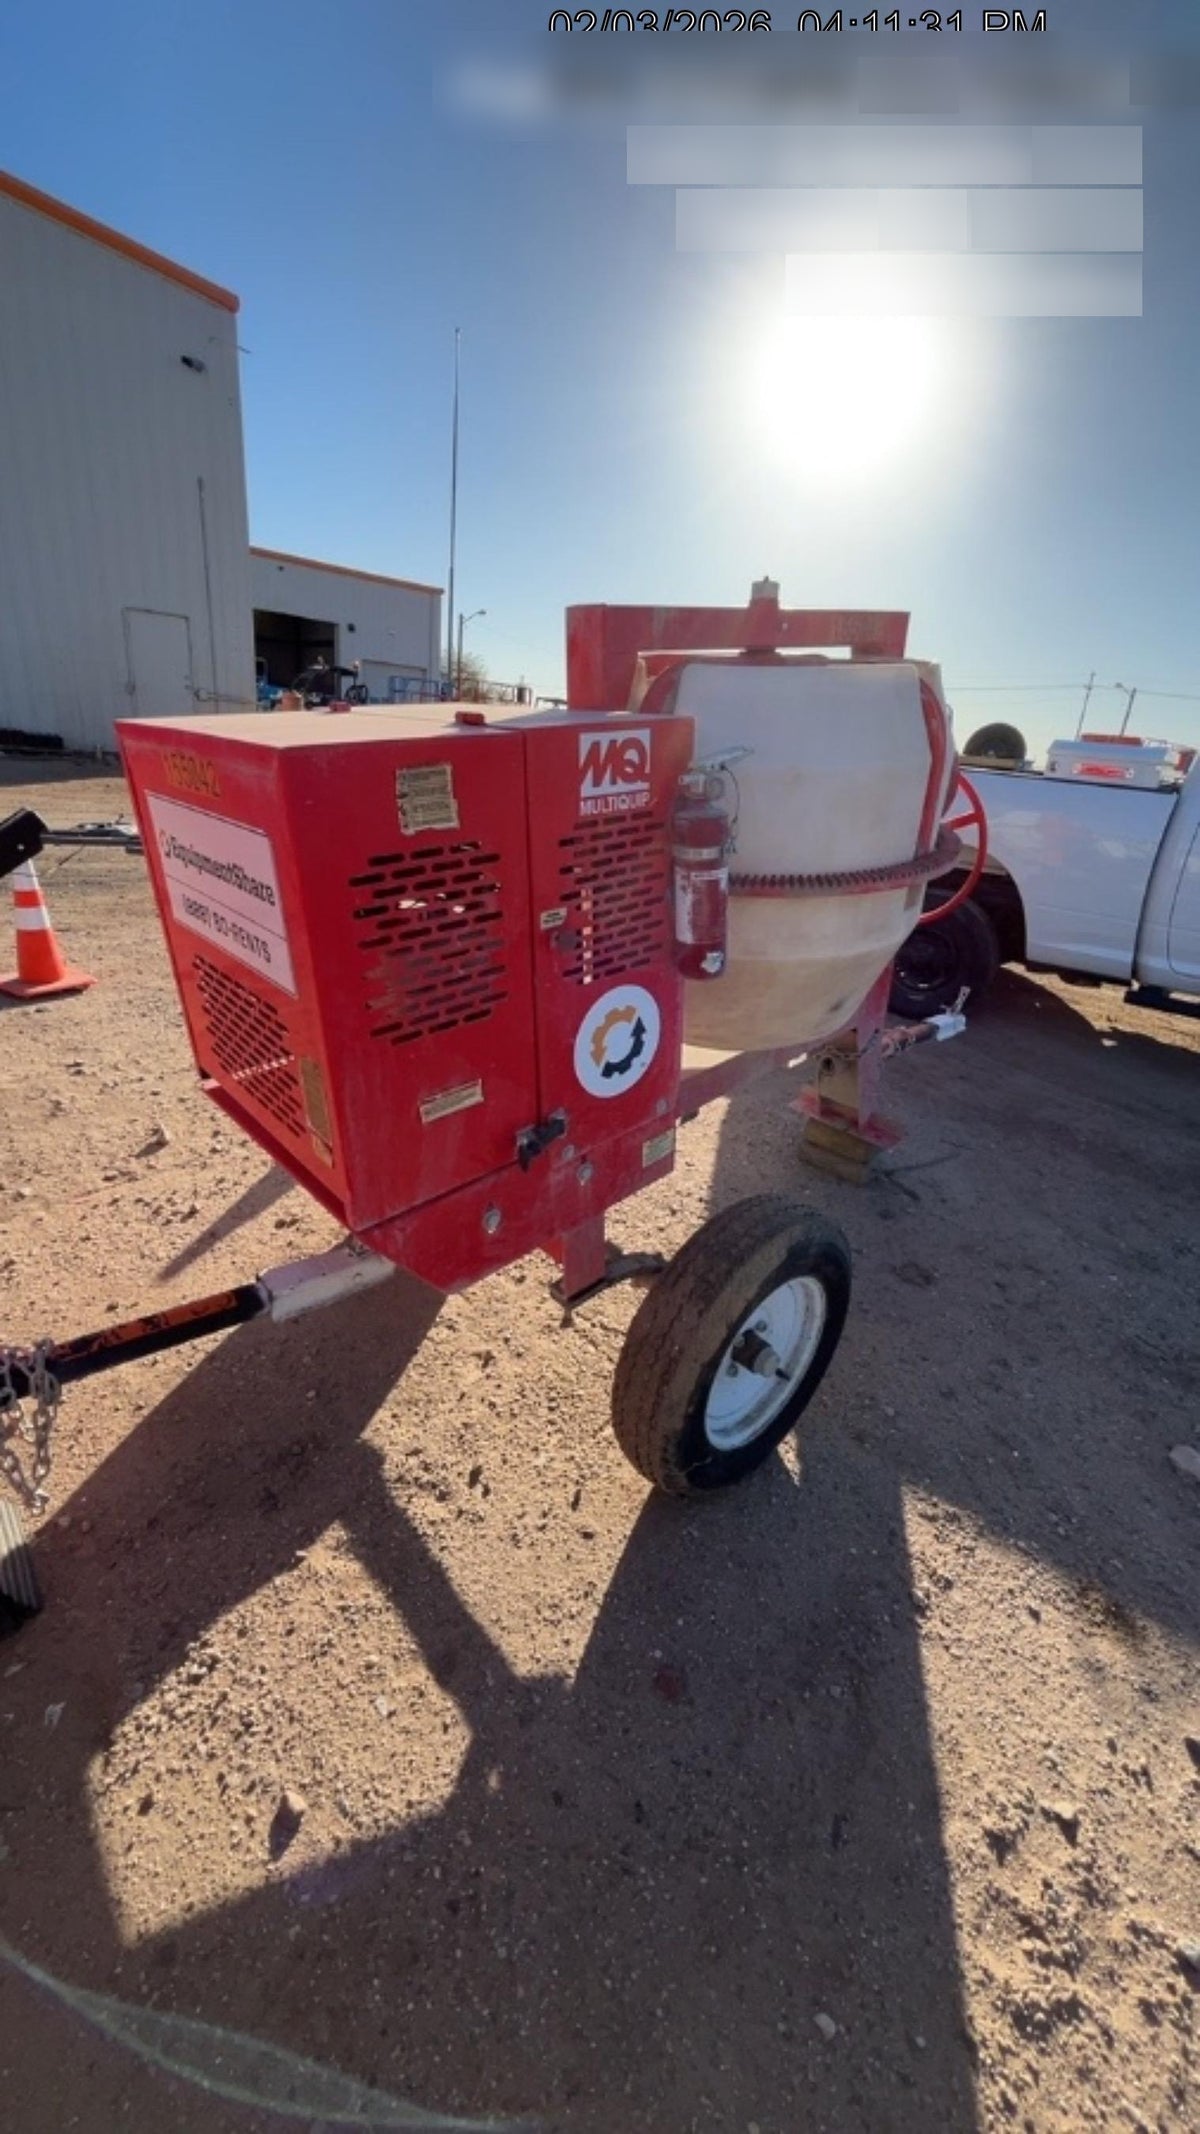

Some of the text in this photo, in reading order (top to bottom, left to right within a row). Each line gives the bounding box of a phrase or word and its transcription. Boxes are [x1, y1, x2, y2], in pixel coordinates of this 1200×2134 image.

[579, 736, 650, 788] MQ
[580, 791, 651, 816] MULTIQUIP
[170, 836, 276, 907] EquipmentShare
